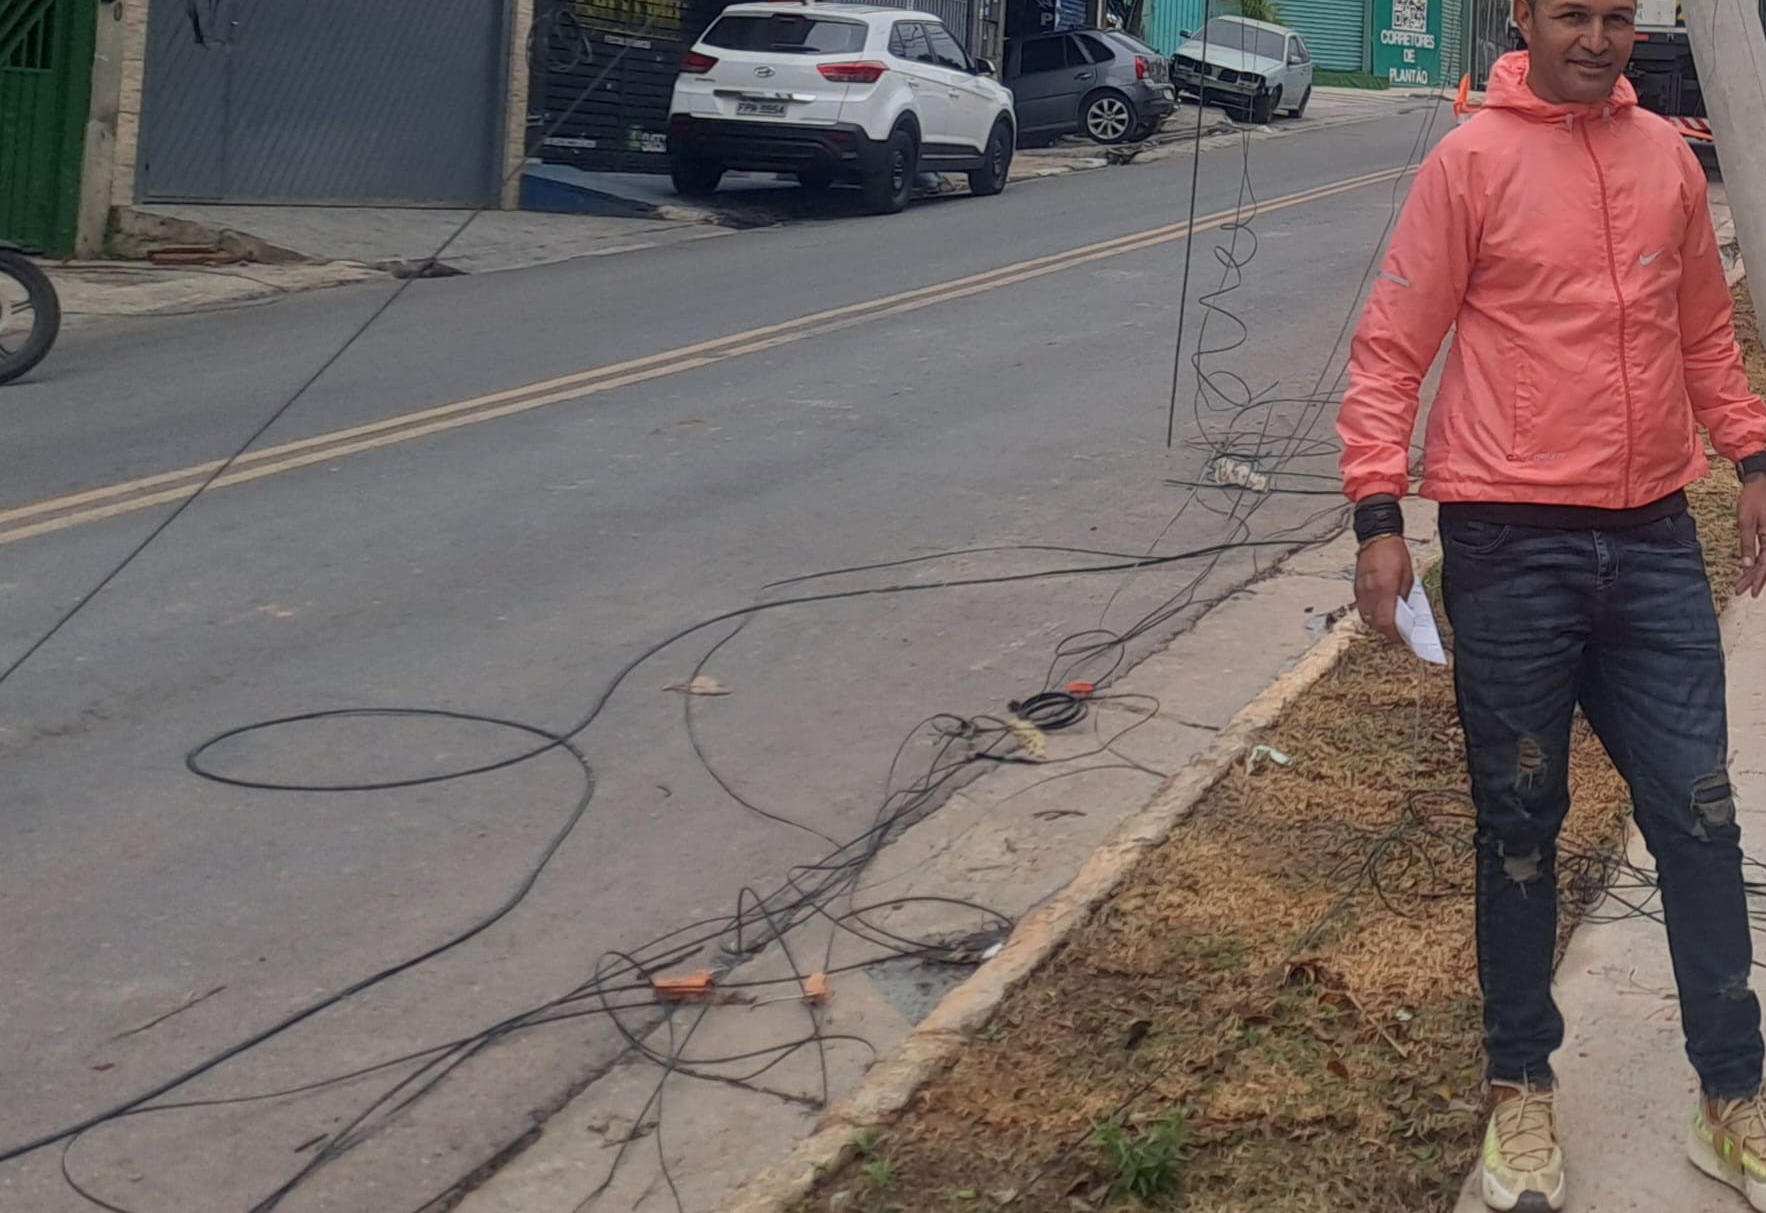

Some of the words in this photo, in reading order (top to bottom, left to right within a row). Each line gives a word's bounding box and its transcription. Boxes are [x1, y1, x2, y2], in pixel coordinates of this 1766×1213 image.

[1380, 29, 1435, 50] CORRETORES
[1403, 48, 1416, 64] DE
[1389, 66, 1428, 85] PLANTÃO
